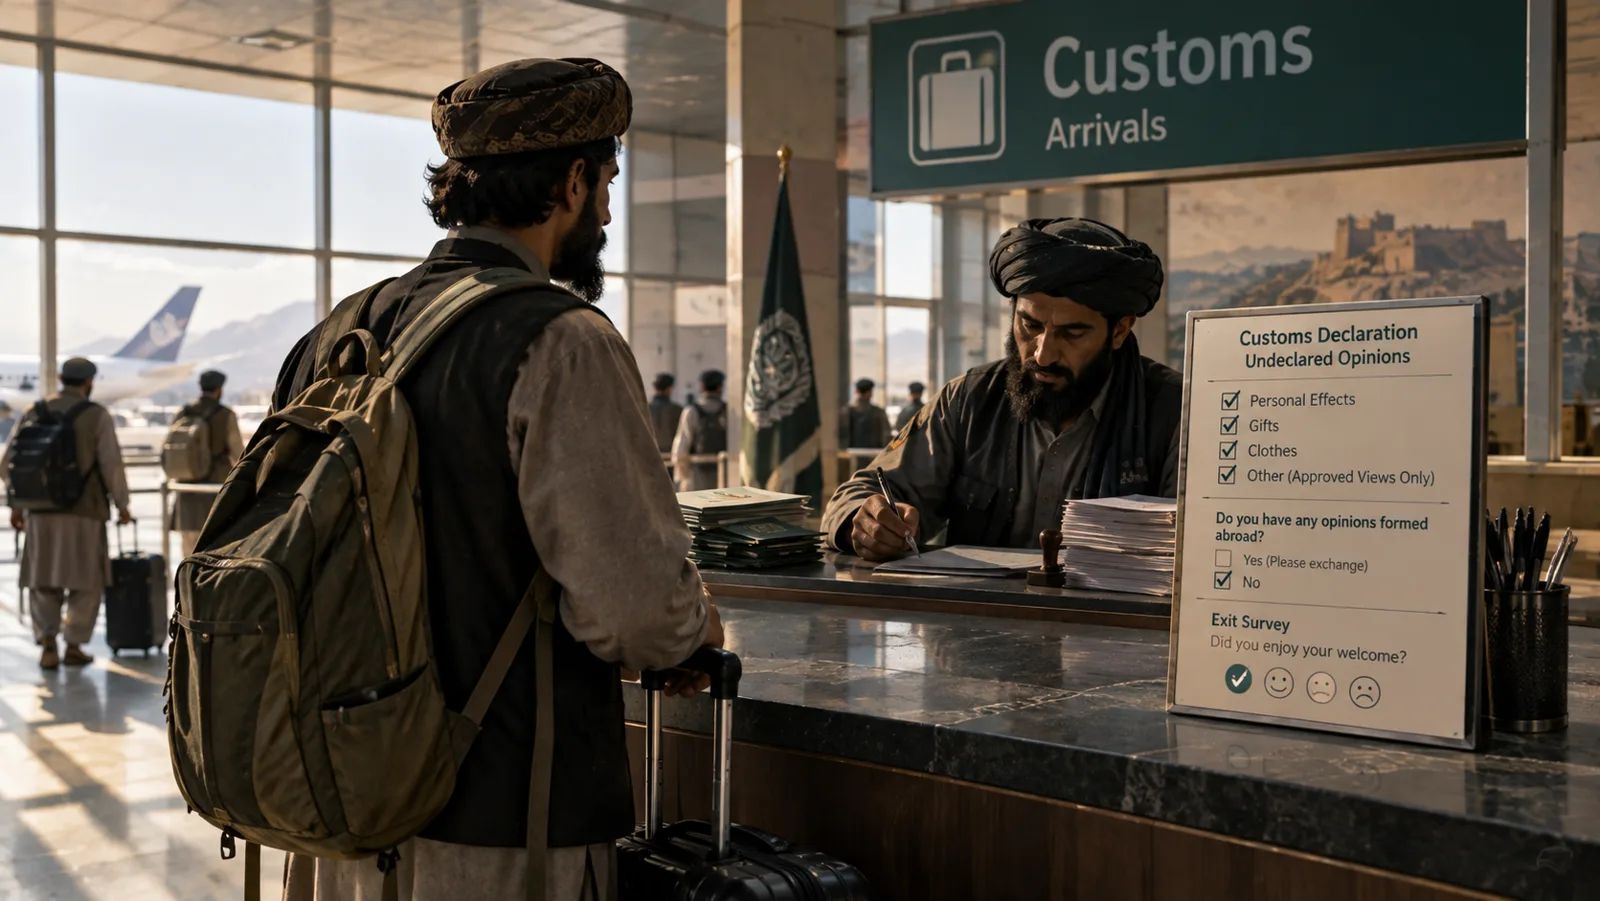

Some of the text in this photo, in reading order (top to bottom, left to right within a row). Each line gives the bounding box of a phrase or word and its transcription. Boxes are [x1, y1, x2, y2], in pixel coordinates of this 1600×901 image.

[1043, 24, 1313, 99] Customs
[1045, 108, 1168, 150] Arrivals
[1240, 324, 1418, 346] Customs Declaration
[1246, 349, 1411, 369] Undeclared Opinions
[1250, 392, 1356, 407] Personal Effects
[1249, 419, 1280, 432] Gifts
[1248, 444, 1298, 457] Clothes
[1247, 469, 1434, 487] Other (Approved Views Only)
[1216, 512, 1428, 531] Do you have any opinions formed
[1216, 529, 1264, 543] abroad?
[1243, 554, 1368, 574] Yes (Please exchange)
[1243, 576, 1260, 589] No
[1212, 613, 1290, 634] Exit Survey
[1210, 635, 1407, 664] Did you enjoy your welcome?
